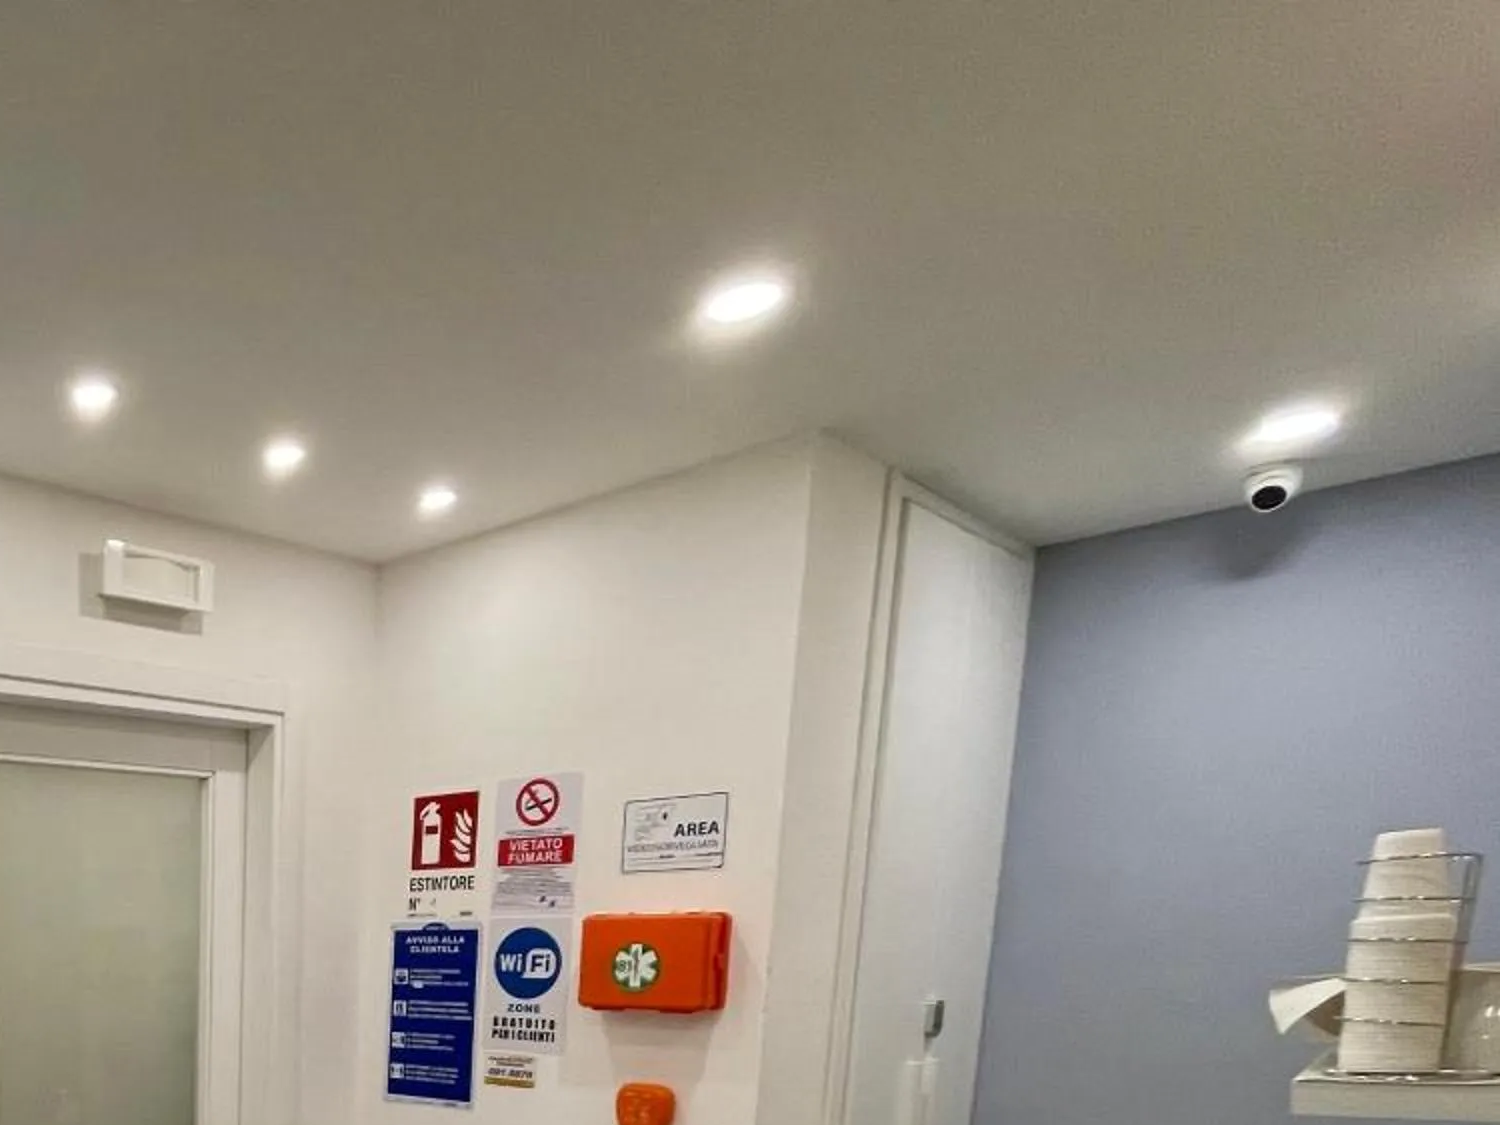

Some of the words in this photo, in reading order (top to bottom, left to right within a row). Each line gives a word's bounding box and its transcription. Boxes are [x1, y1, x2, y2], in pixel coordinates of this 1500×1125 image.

[673, 820, 720, 838] AREA
[509, 837, 563, 851] VIETATO
[507, 850, 562, 864] FUMARE
[409, 875, 476, 892] ESTINTORE
[405, 935, 440, 945] AVVISO
[442, 935, 465, 945] ALLA
[507, 1003, 541, 1014] ZONE
[493, 1016, 556, 1031] GRATUITO
